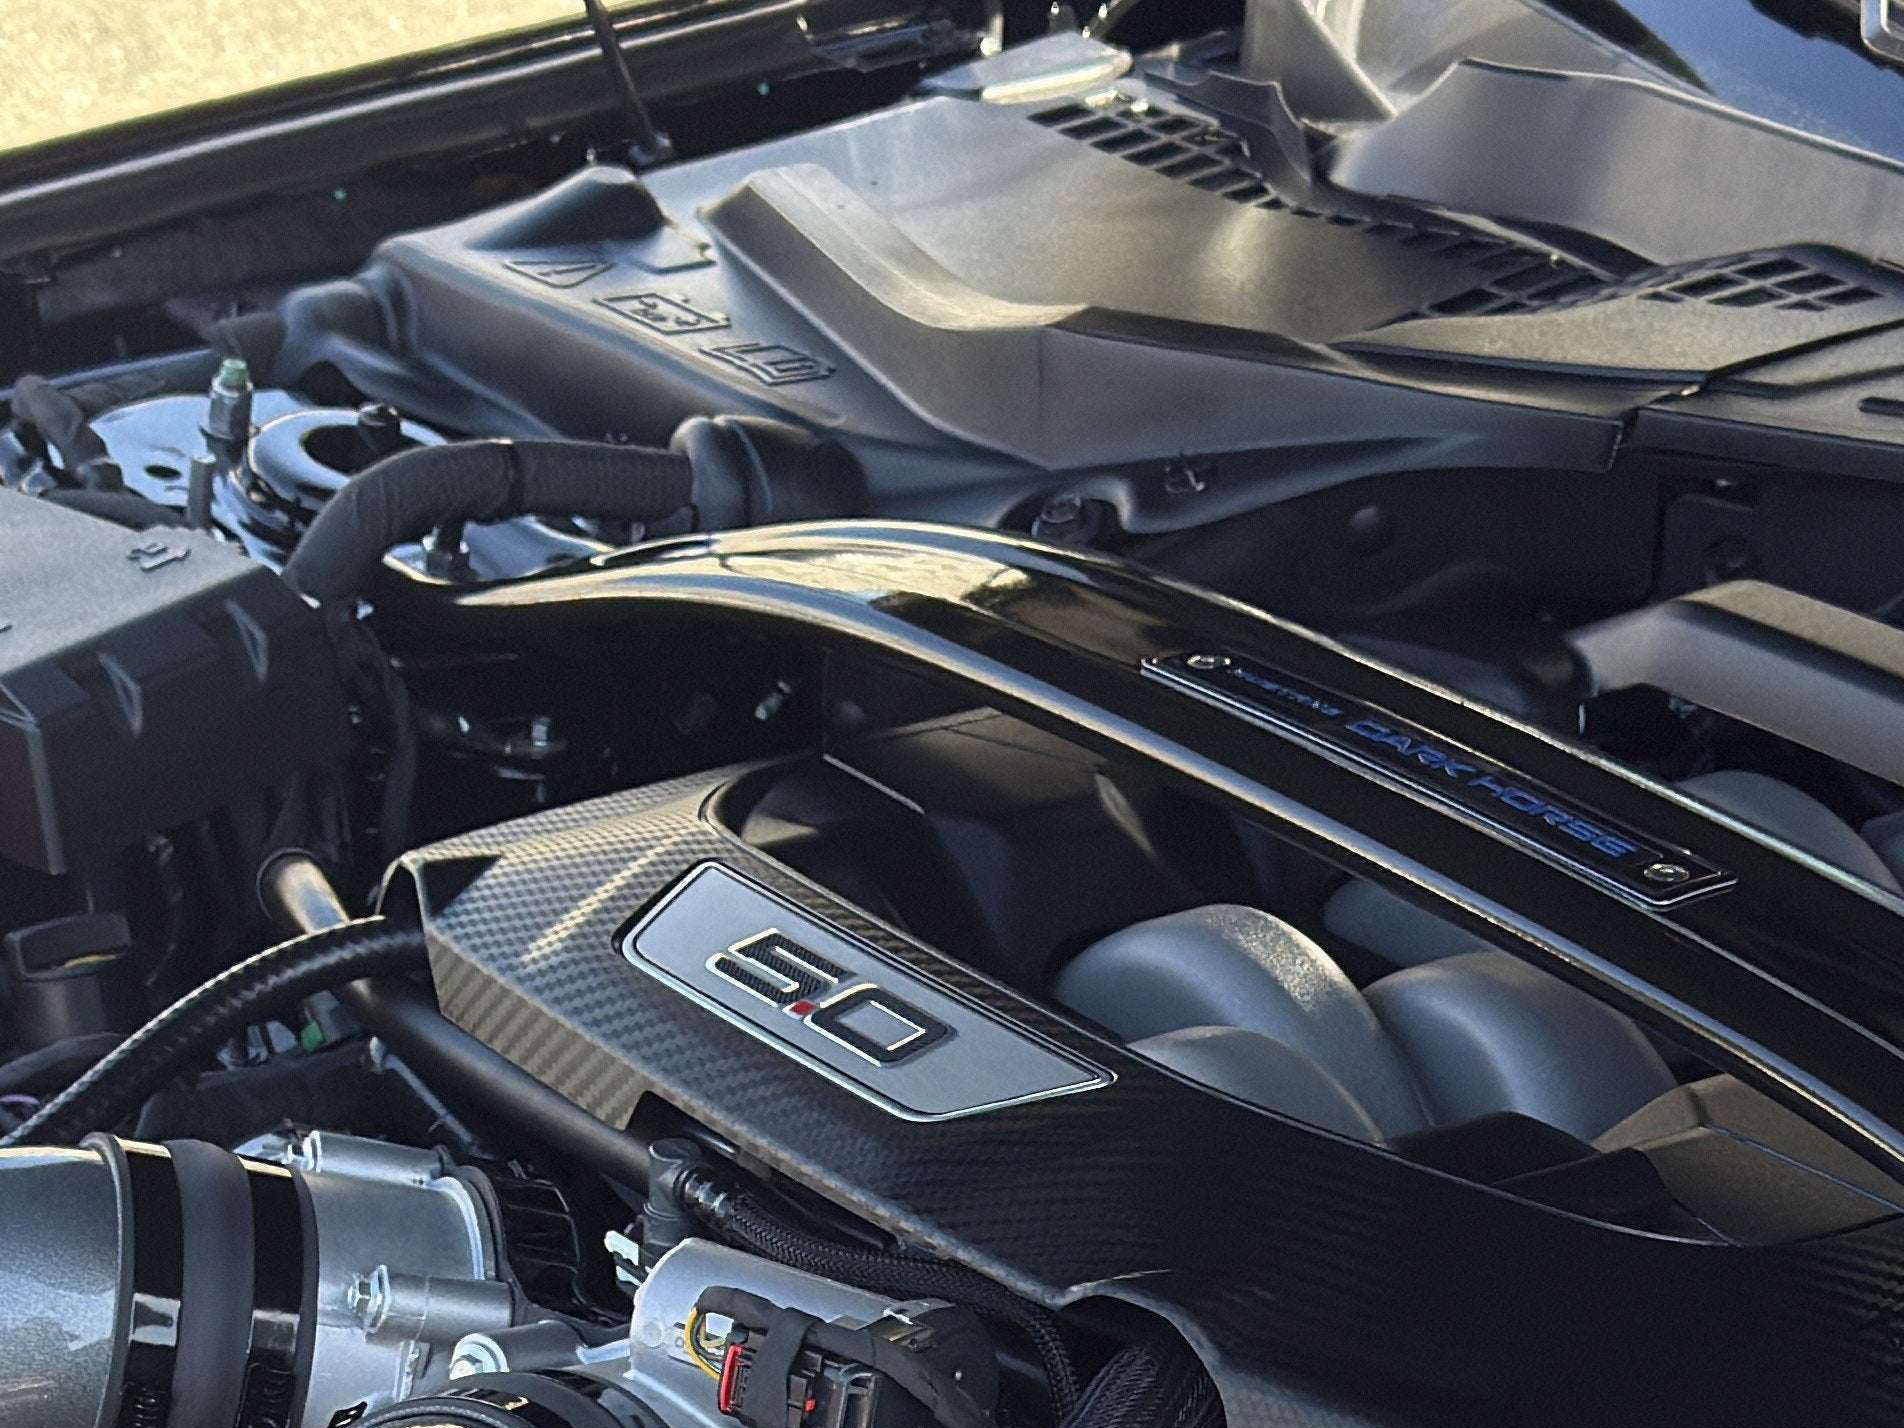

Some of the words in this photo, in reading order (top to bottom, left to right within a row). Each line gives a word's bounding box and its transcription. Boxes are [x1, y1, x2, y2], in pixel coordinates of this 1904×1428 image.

[1346, 720, 1475, 778] DARK
[1467, 775, 1639, 857] HORSE
[704, 925, 952, 1069] 5.0
